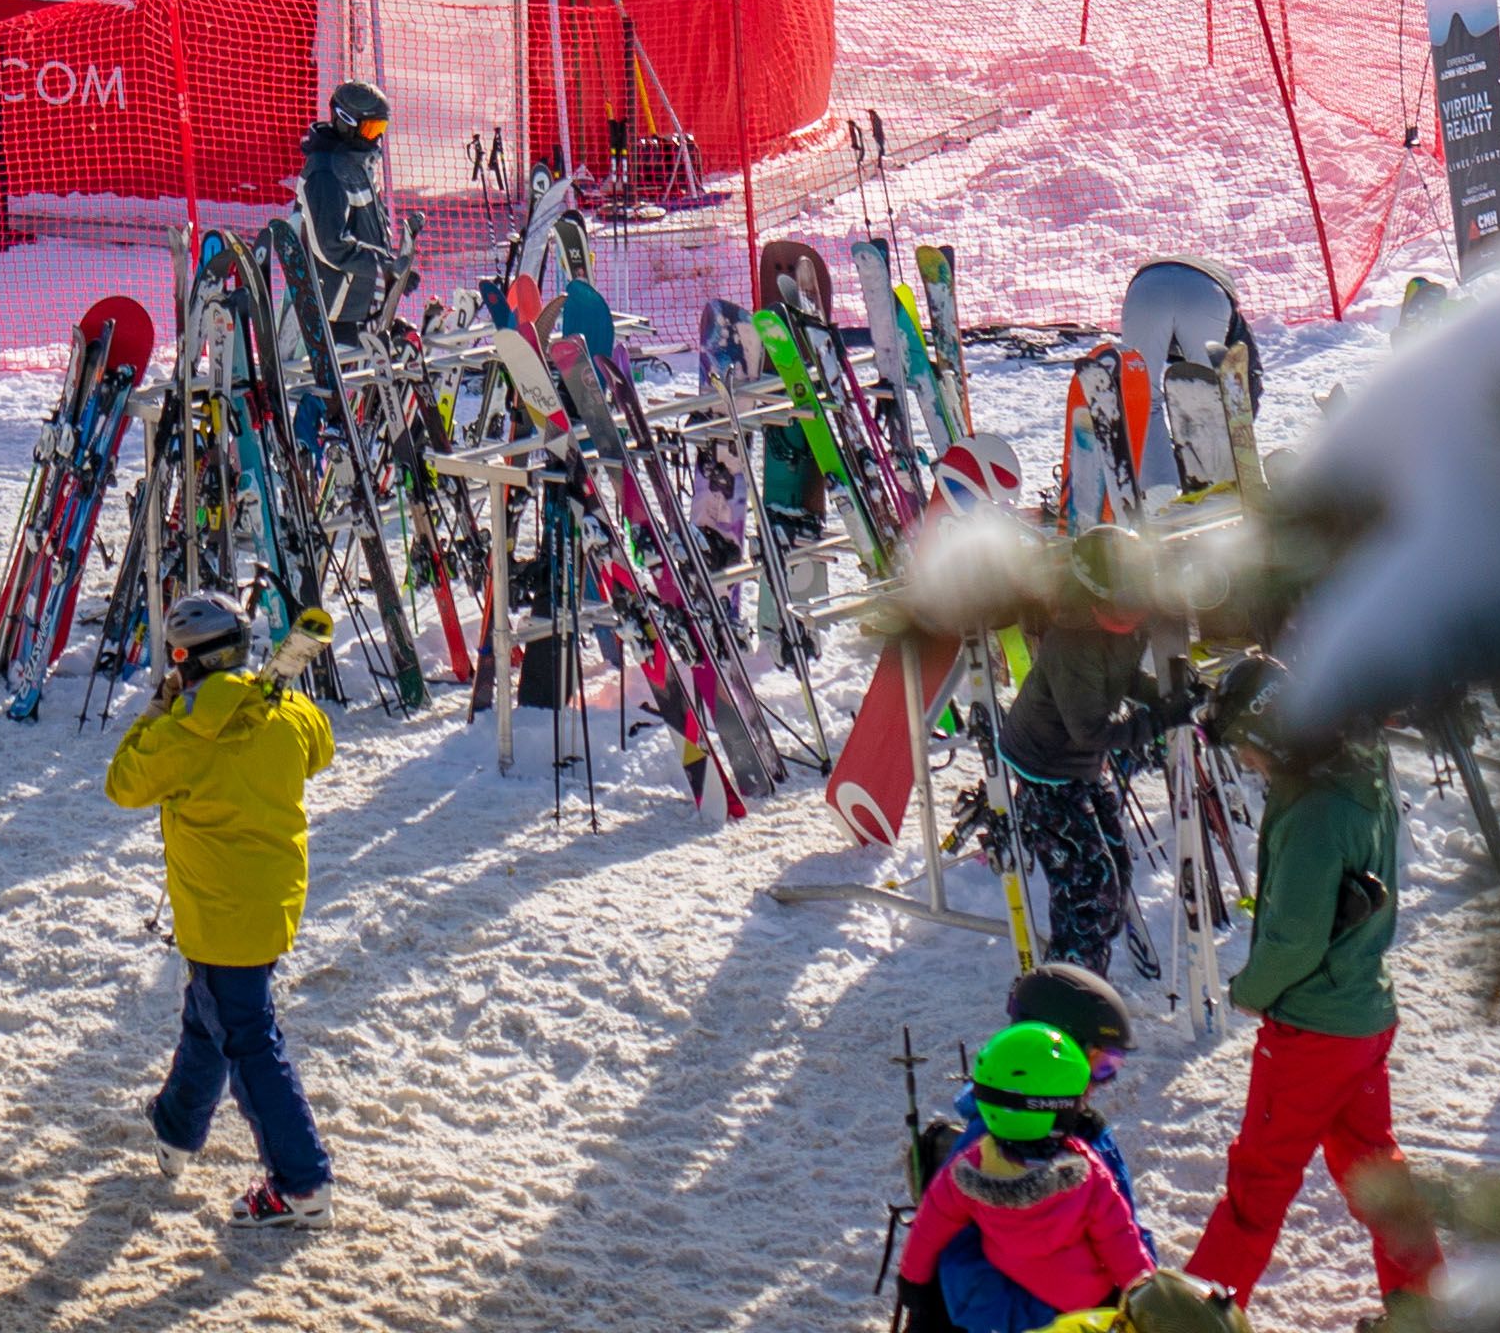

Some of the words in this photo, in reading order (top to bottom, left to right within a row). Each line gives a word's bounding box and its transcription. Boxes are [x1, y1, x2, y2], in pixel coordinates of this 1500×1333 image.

[1442, 91, 1493, 121] VIRTUAL
[1446, 112, 1493, 142] REALITY
[1025, 1098, 1076, 1110] SMITH
